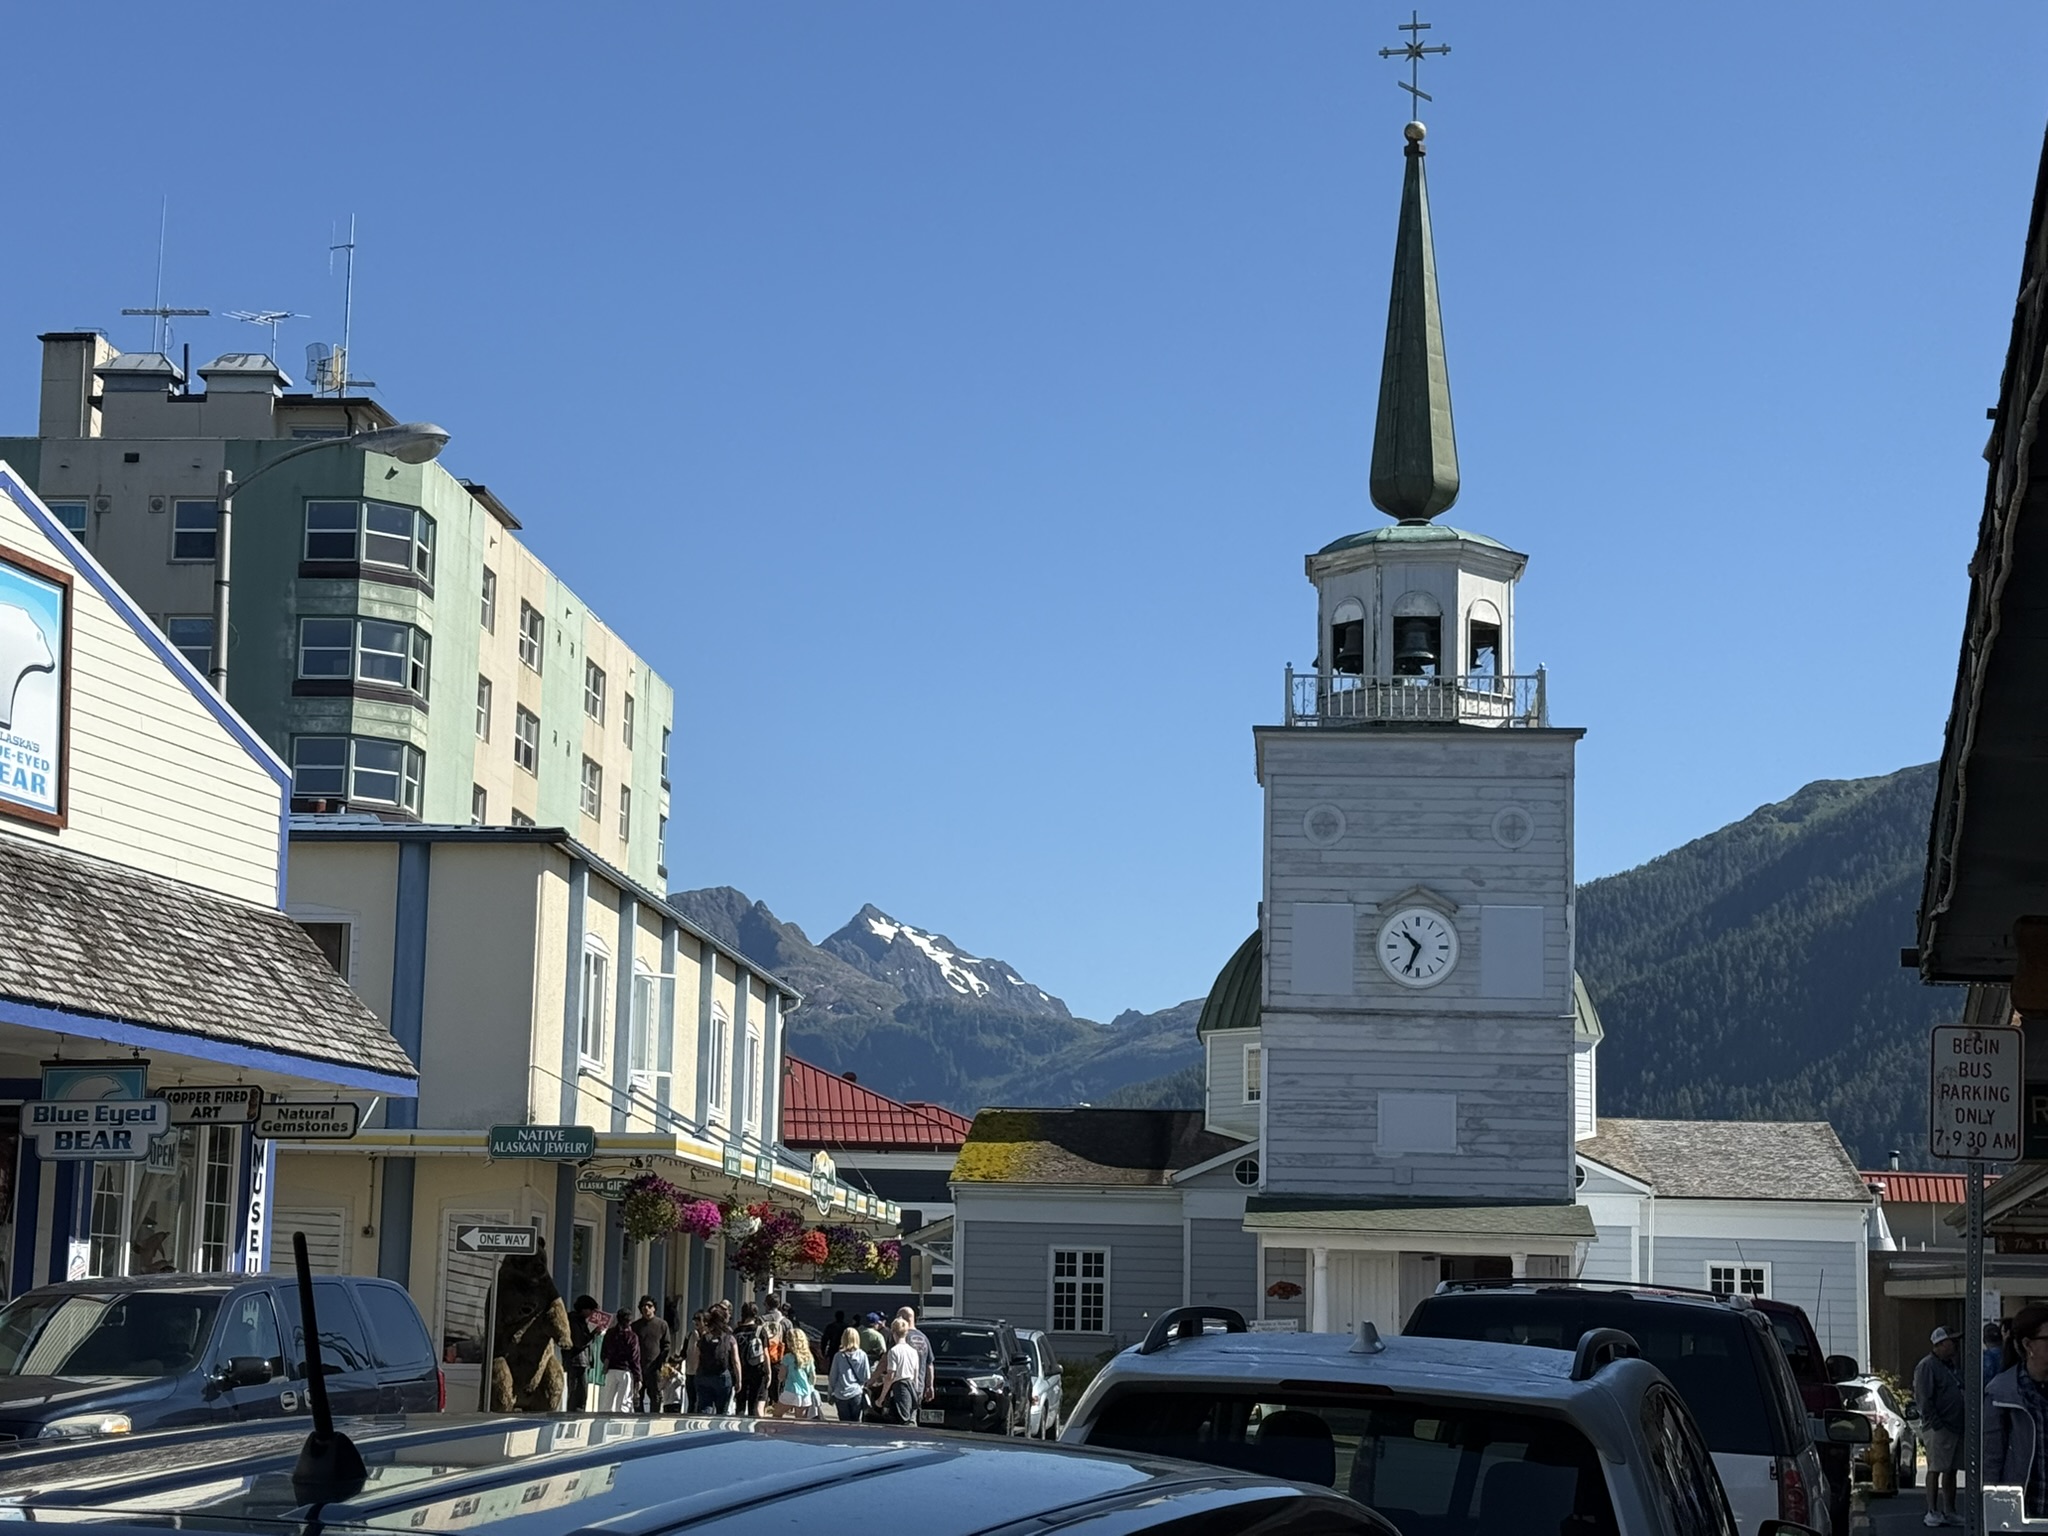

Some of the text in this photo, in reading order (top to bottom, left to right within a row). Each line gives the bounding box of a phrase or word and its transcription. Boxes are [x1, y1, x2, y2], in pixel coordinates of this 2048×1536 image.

[0, 761, 46, 796] EAR
[1952, 1037, 2000, 1055] BEGIN
[1959, 1061, 1992, 1079] BUS
[167, 1090, 249, 1104] COPPER FIRED
[1940, 1083, 2010, 1103] PARKING
[33, 1105, 157, 1126] Blue Eyed
[190, 1106, 222, 1119] ART
[277, 1107, 335, 1120] Natural
[1955, 1107, 1996, 1125] ONLY
[261, 1120, 348, 1133] Gemstones
[54, 1130, 132, 1151] BEAR
[518, 1130, 565, 1142] NATIVE
[1992, 1132, 2017, 1150] AM
[150, 1141, 176, 1167] OPEN
[492, 1142, 590, 1155] ALASKAN JEWELRY
[579, 1181, 604, 1190] ALASKA
[480, 1233, 527, 1246] ONE WAY
